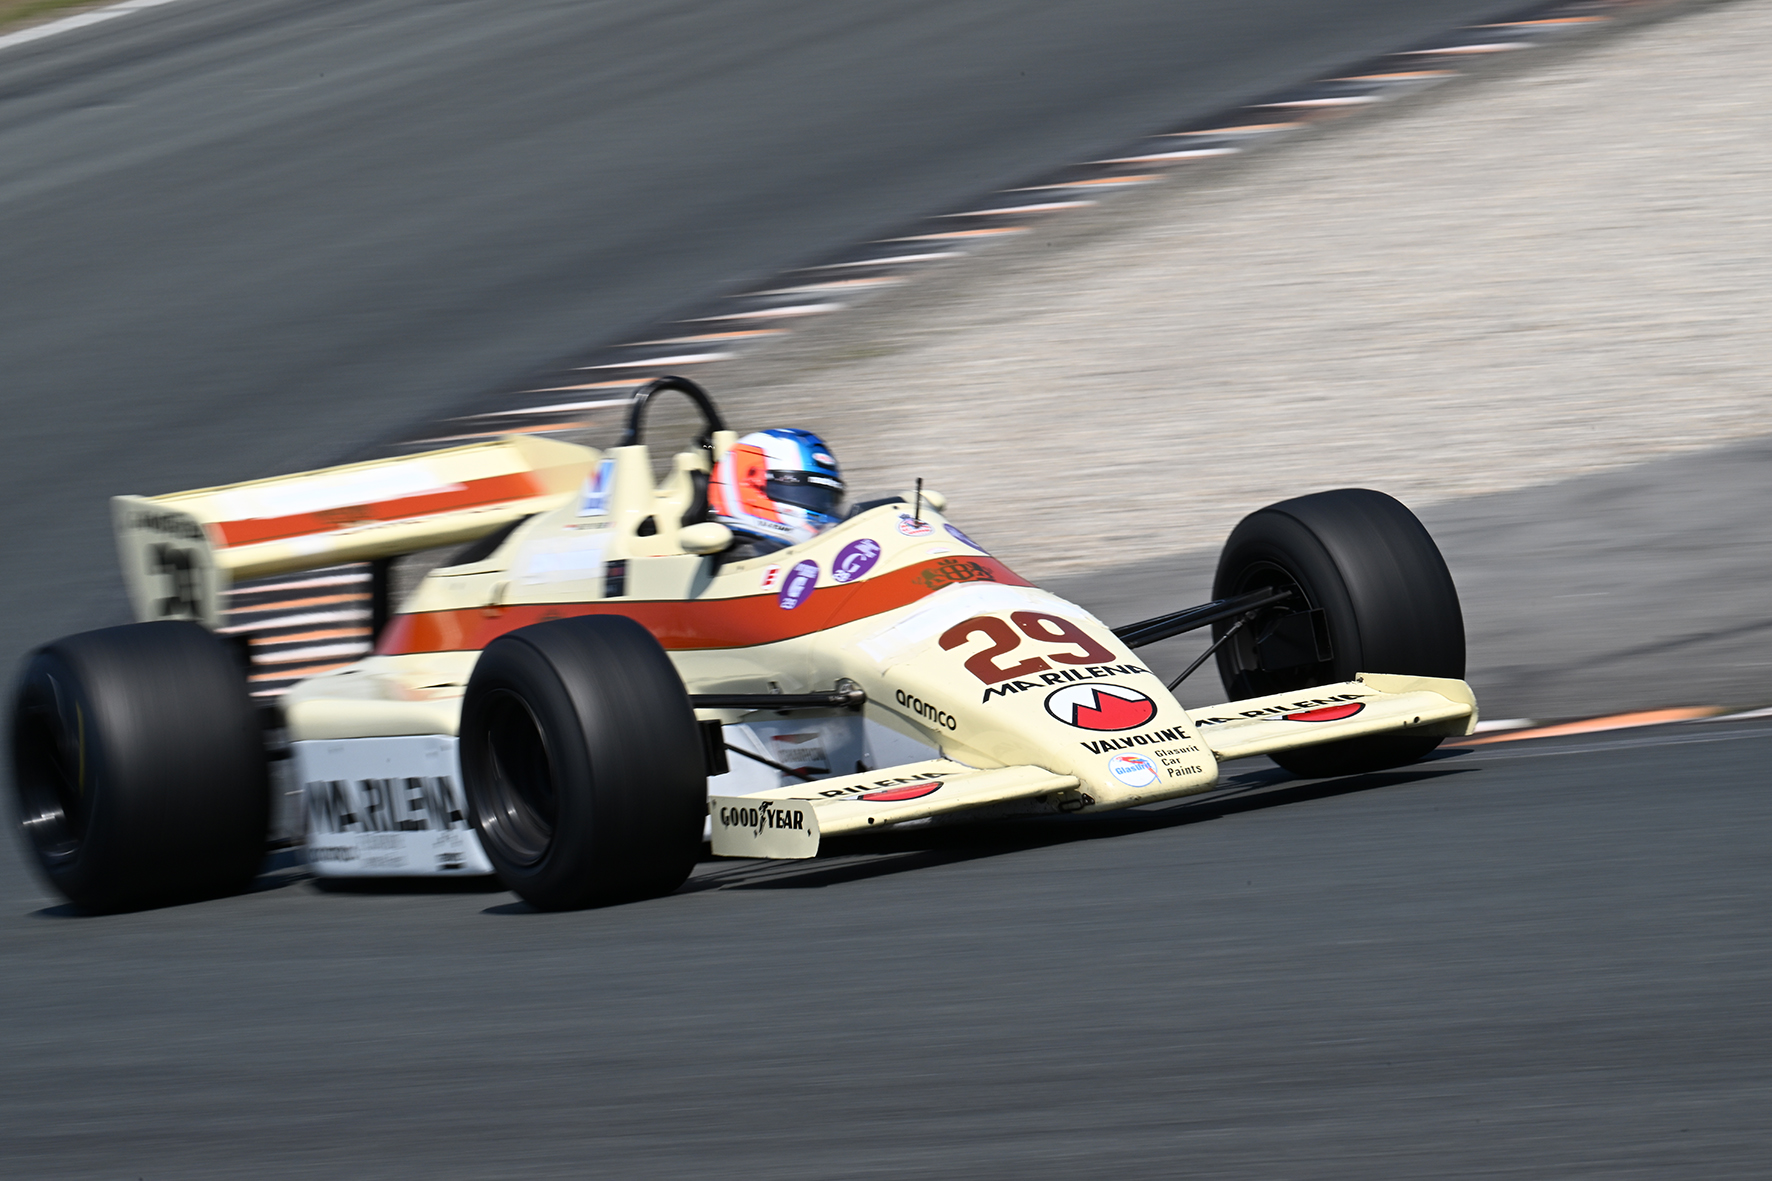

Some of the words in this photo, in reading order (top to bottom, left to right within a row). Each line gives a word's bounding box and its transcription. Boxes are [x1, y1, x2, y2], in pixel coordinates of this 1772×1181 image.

[938, 611, 1116, 686] 29
[895, 688, 957, 731] aramco
[1080, 725, 1192, 755] VALVOLINE
[1154, 745, 1200, 758] Glasurit
[1115, 761, 1152, 775] Glasurit
[1161, 758, 1181, 767] Car
[1167, 765, 1203, 778] Paints
